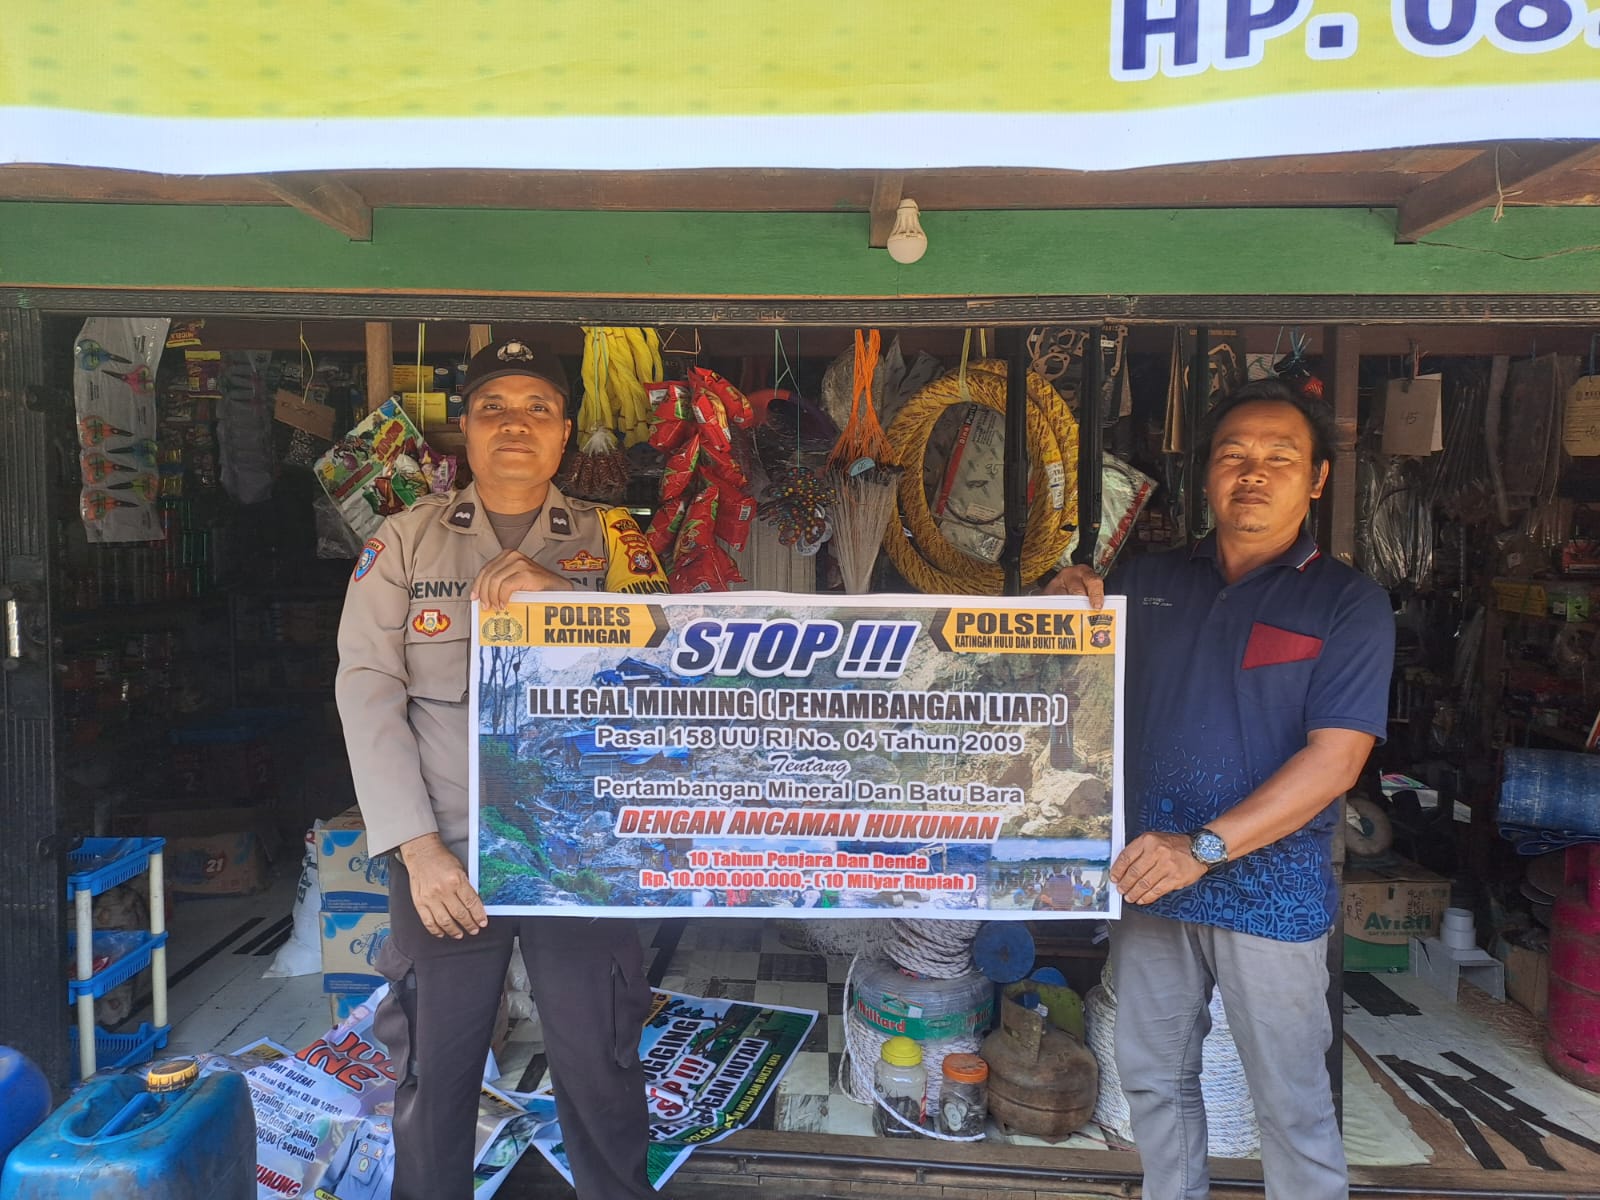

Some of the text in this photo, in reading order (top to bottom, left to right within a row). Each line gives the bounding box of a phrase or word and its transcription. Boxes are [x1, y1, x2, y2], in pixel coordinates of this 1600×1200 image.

[1120, 0, 1345, 71] HP.
[410, 581, 467, 600] ENNY
[543, 605, 631, 627] POLRES
[955, 611, 1075, 636] POLSEK
[543, 627, 631, 645] KATINGAN
[674, 620, 918, 674] STOP !!!
[953, 634, 1078, 651] KATINGAN HULU DAN BUKIT RAYA
[528, 688, 629, 716] ILLEGAL
[636, 689, 756, 718] MINNING
[597, 728, 1023, 752] Pasal 158 UU RI No. 04 Tahun 2009
[769, 754, 848, 779] Tentang
[596, 778, 1022, 803] Pertambangan Mineral Dan Batu Bara
[618, 809, 1000, 840] DENGAN ANCAMAN HUKUMAN
[205, 858, 224, 873] 21
[688, 851, 927, 870] 10 Tahun Penjara Dan Denda
[641, 871, 669, 888] Rp.
[670, 871, 811, 889] 10.000.000.000,-
[824, 874, 843, 888] 10
[847, 875, 900, 892] Milyar
[904, 875, 964, 892] Rupiah
[640, 1019, 702, 1081] OGGING
[720, 1038, 768, 1081] HUTAN
[267, 1062, 317, 1089] APAT DIJERAT
[258, 1091, 284, 1113] paling
[284, 1102, 304, 1120] lama
[303, 1111, 316, 1125] 10
[268, 1113, 294, 1134] denda
[291, 1129, 319, 1148] paling
[281, 1140, 316, 1162] sepuluh
